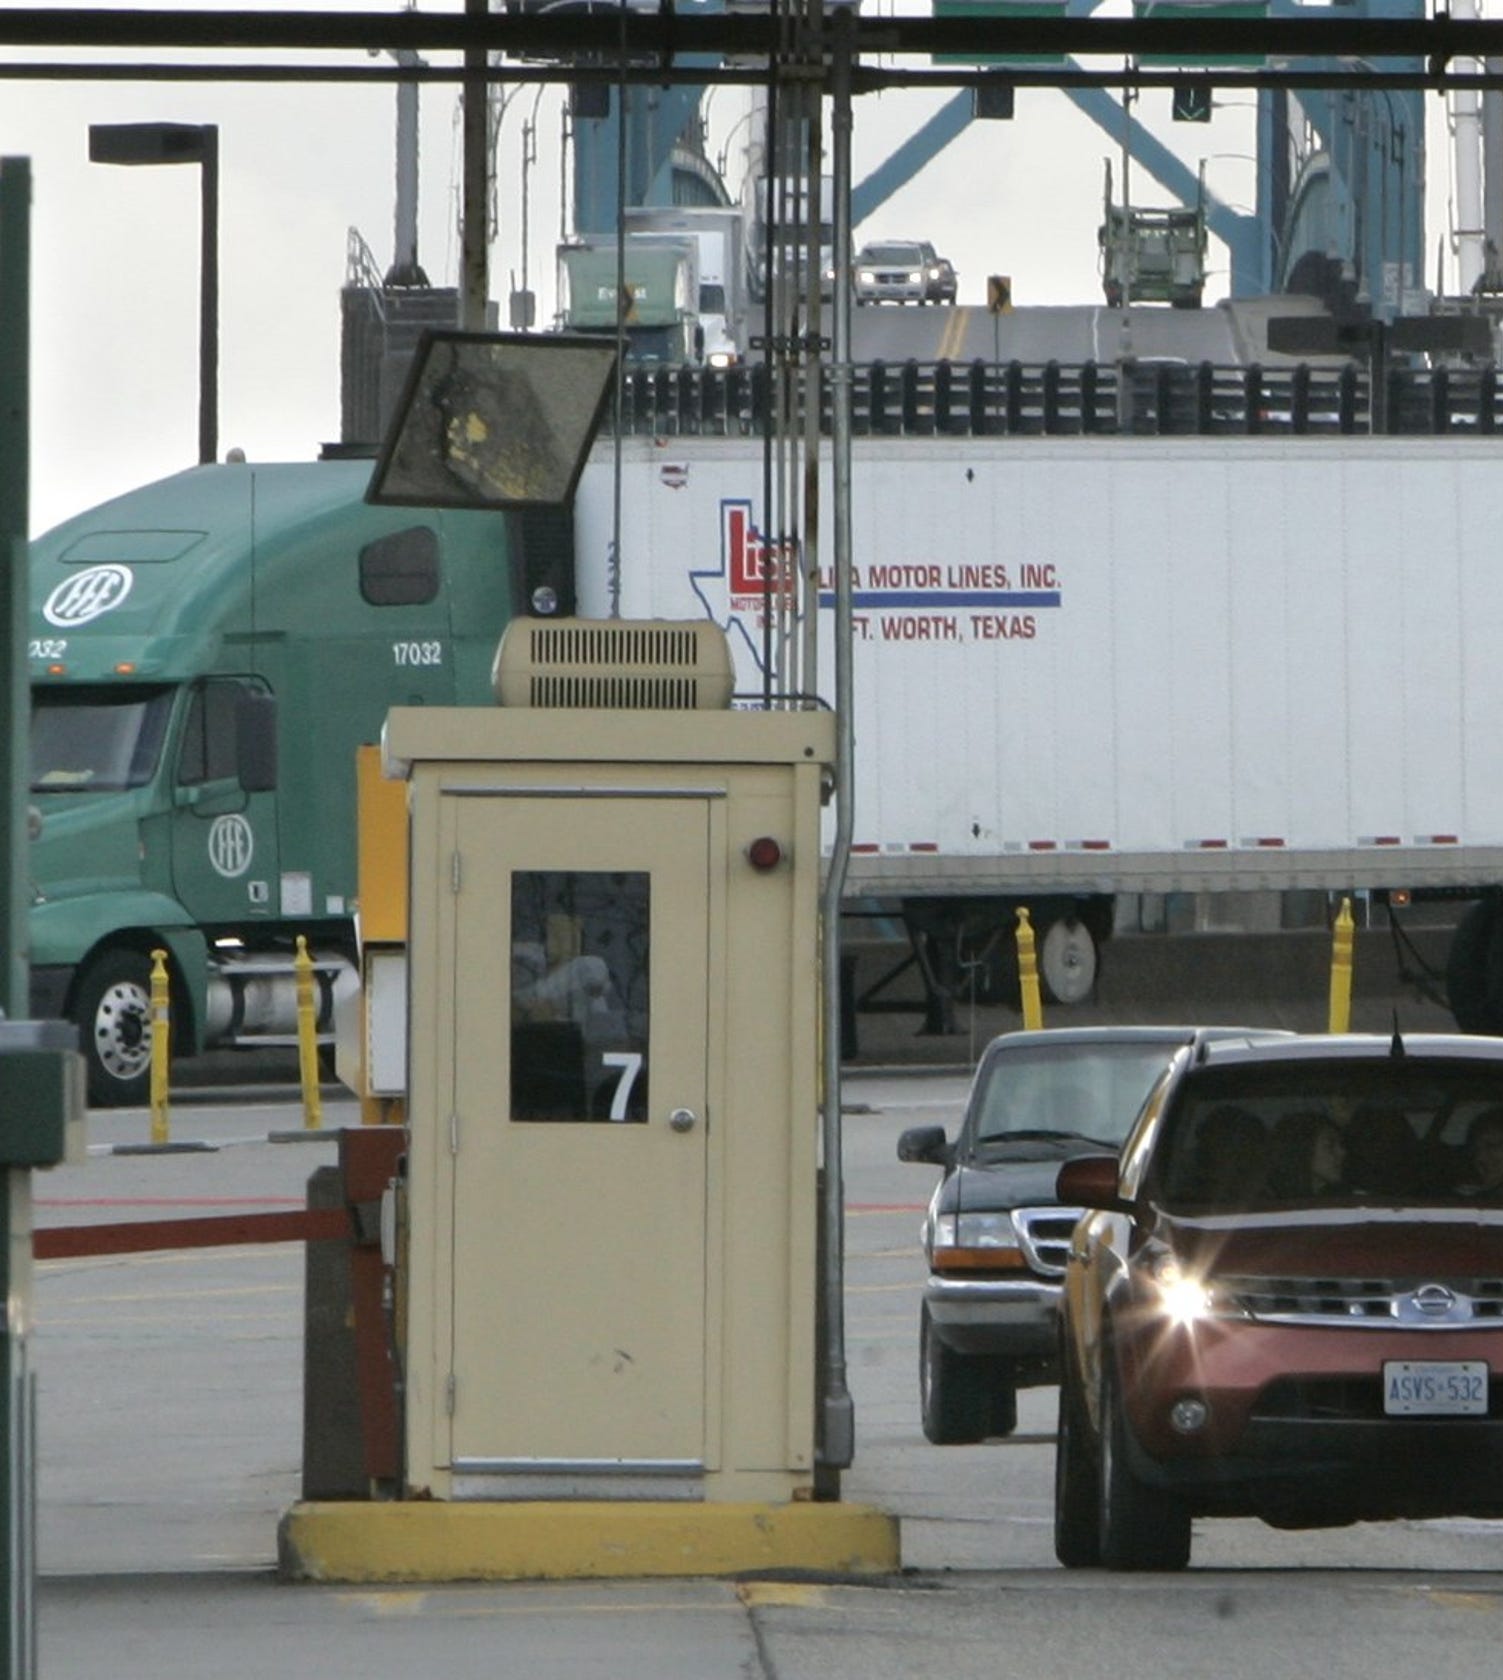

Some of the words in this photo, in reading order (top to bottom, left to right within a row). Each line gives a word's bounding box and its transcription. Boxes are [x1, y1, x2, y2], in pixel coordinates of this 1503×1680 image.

[818, 565, 861, 588] LIA
[869, 564, 942, 589] MOTOR
[948, 564, 1011, 590] LINES,
[1020, 563, 1062, 588] INC.
[850, 617, 873, 640] FT.
[881, 615, 964, 643] WORTH,
[970, 615, 1036, 640] TEXAS
[392, 642, 442, 666] 17032
[603, 1052, 642, 1121] 7
